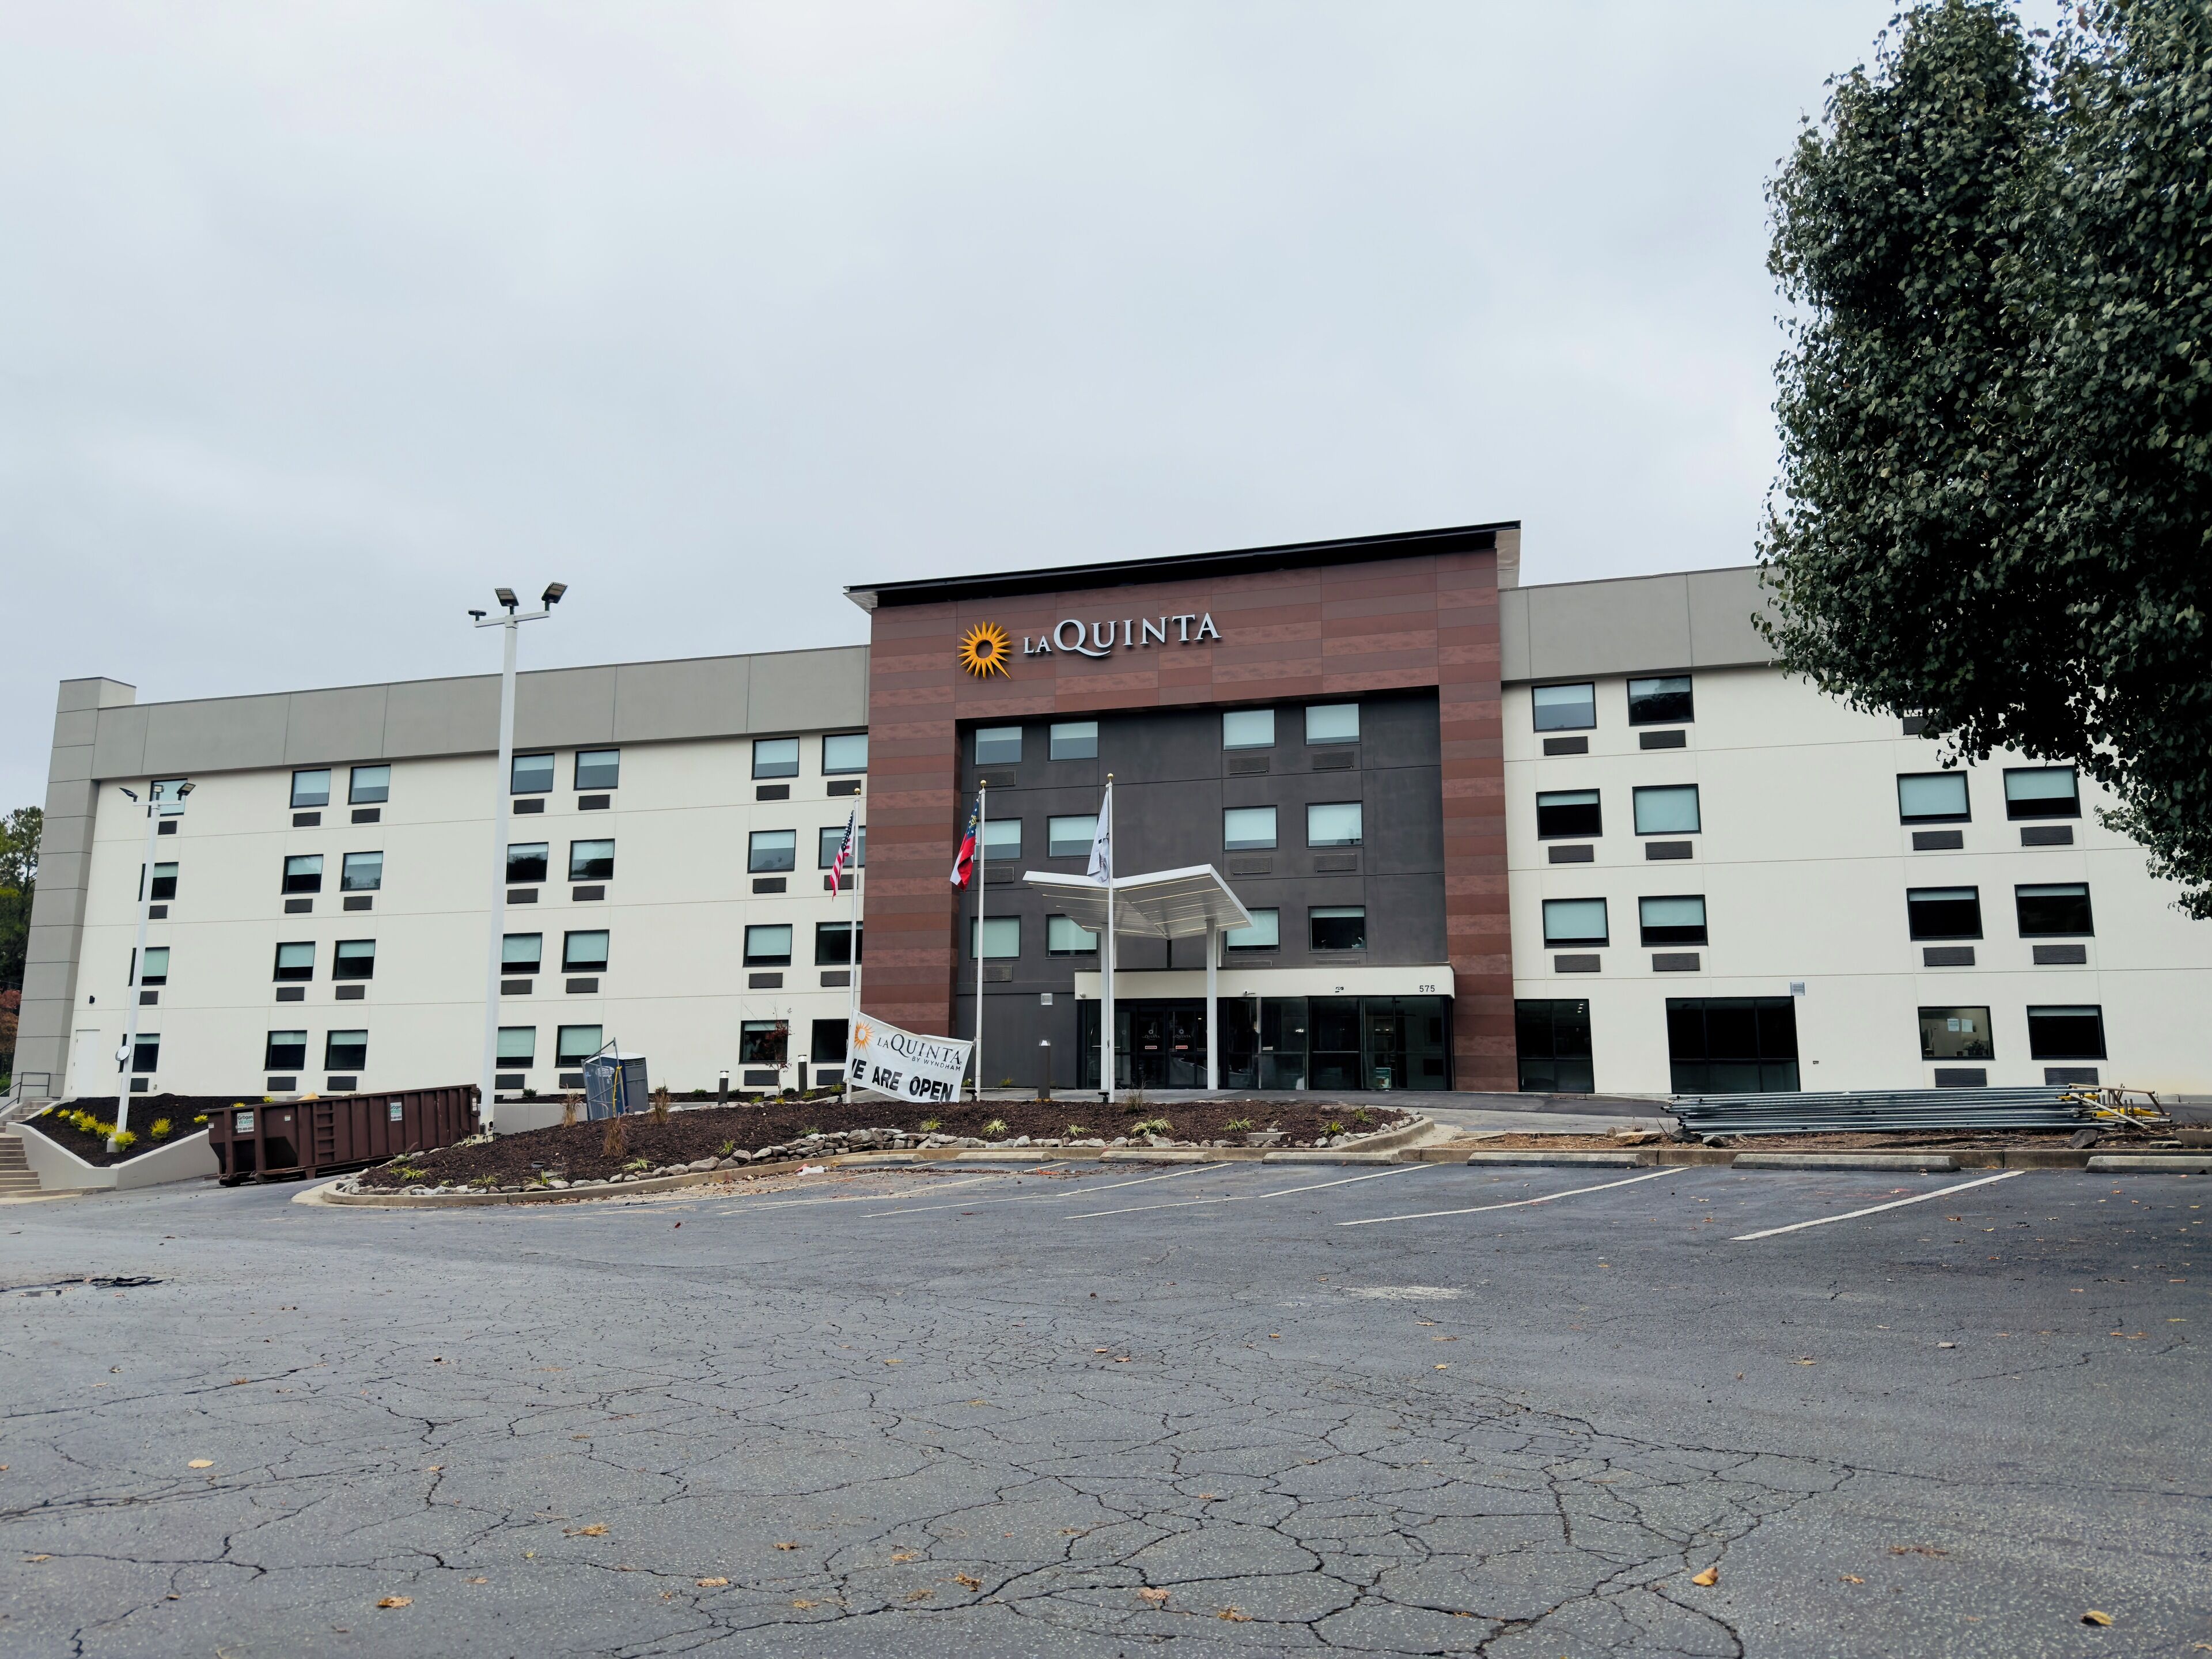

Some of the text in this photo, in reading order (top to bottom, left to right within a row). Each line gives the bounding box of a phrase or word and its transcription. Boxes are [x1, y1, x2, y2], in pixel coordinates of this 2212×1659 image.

[1023, 612, 1222, 657] LA QUINTA
[877, 1033, 961, 1065] LA QUINTA
[923, 1059, 961, 1071] WYNDHAM
[872, 1066, 903, 1091] ARE
[910, 1076, 954, 1102] OPEN
